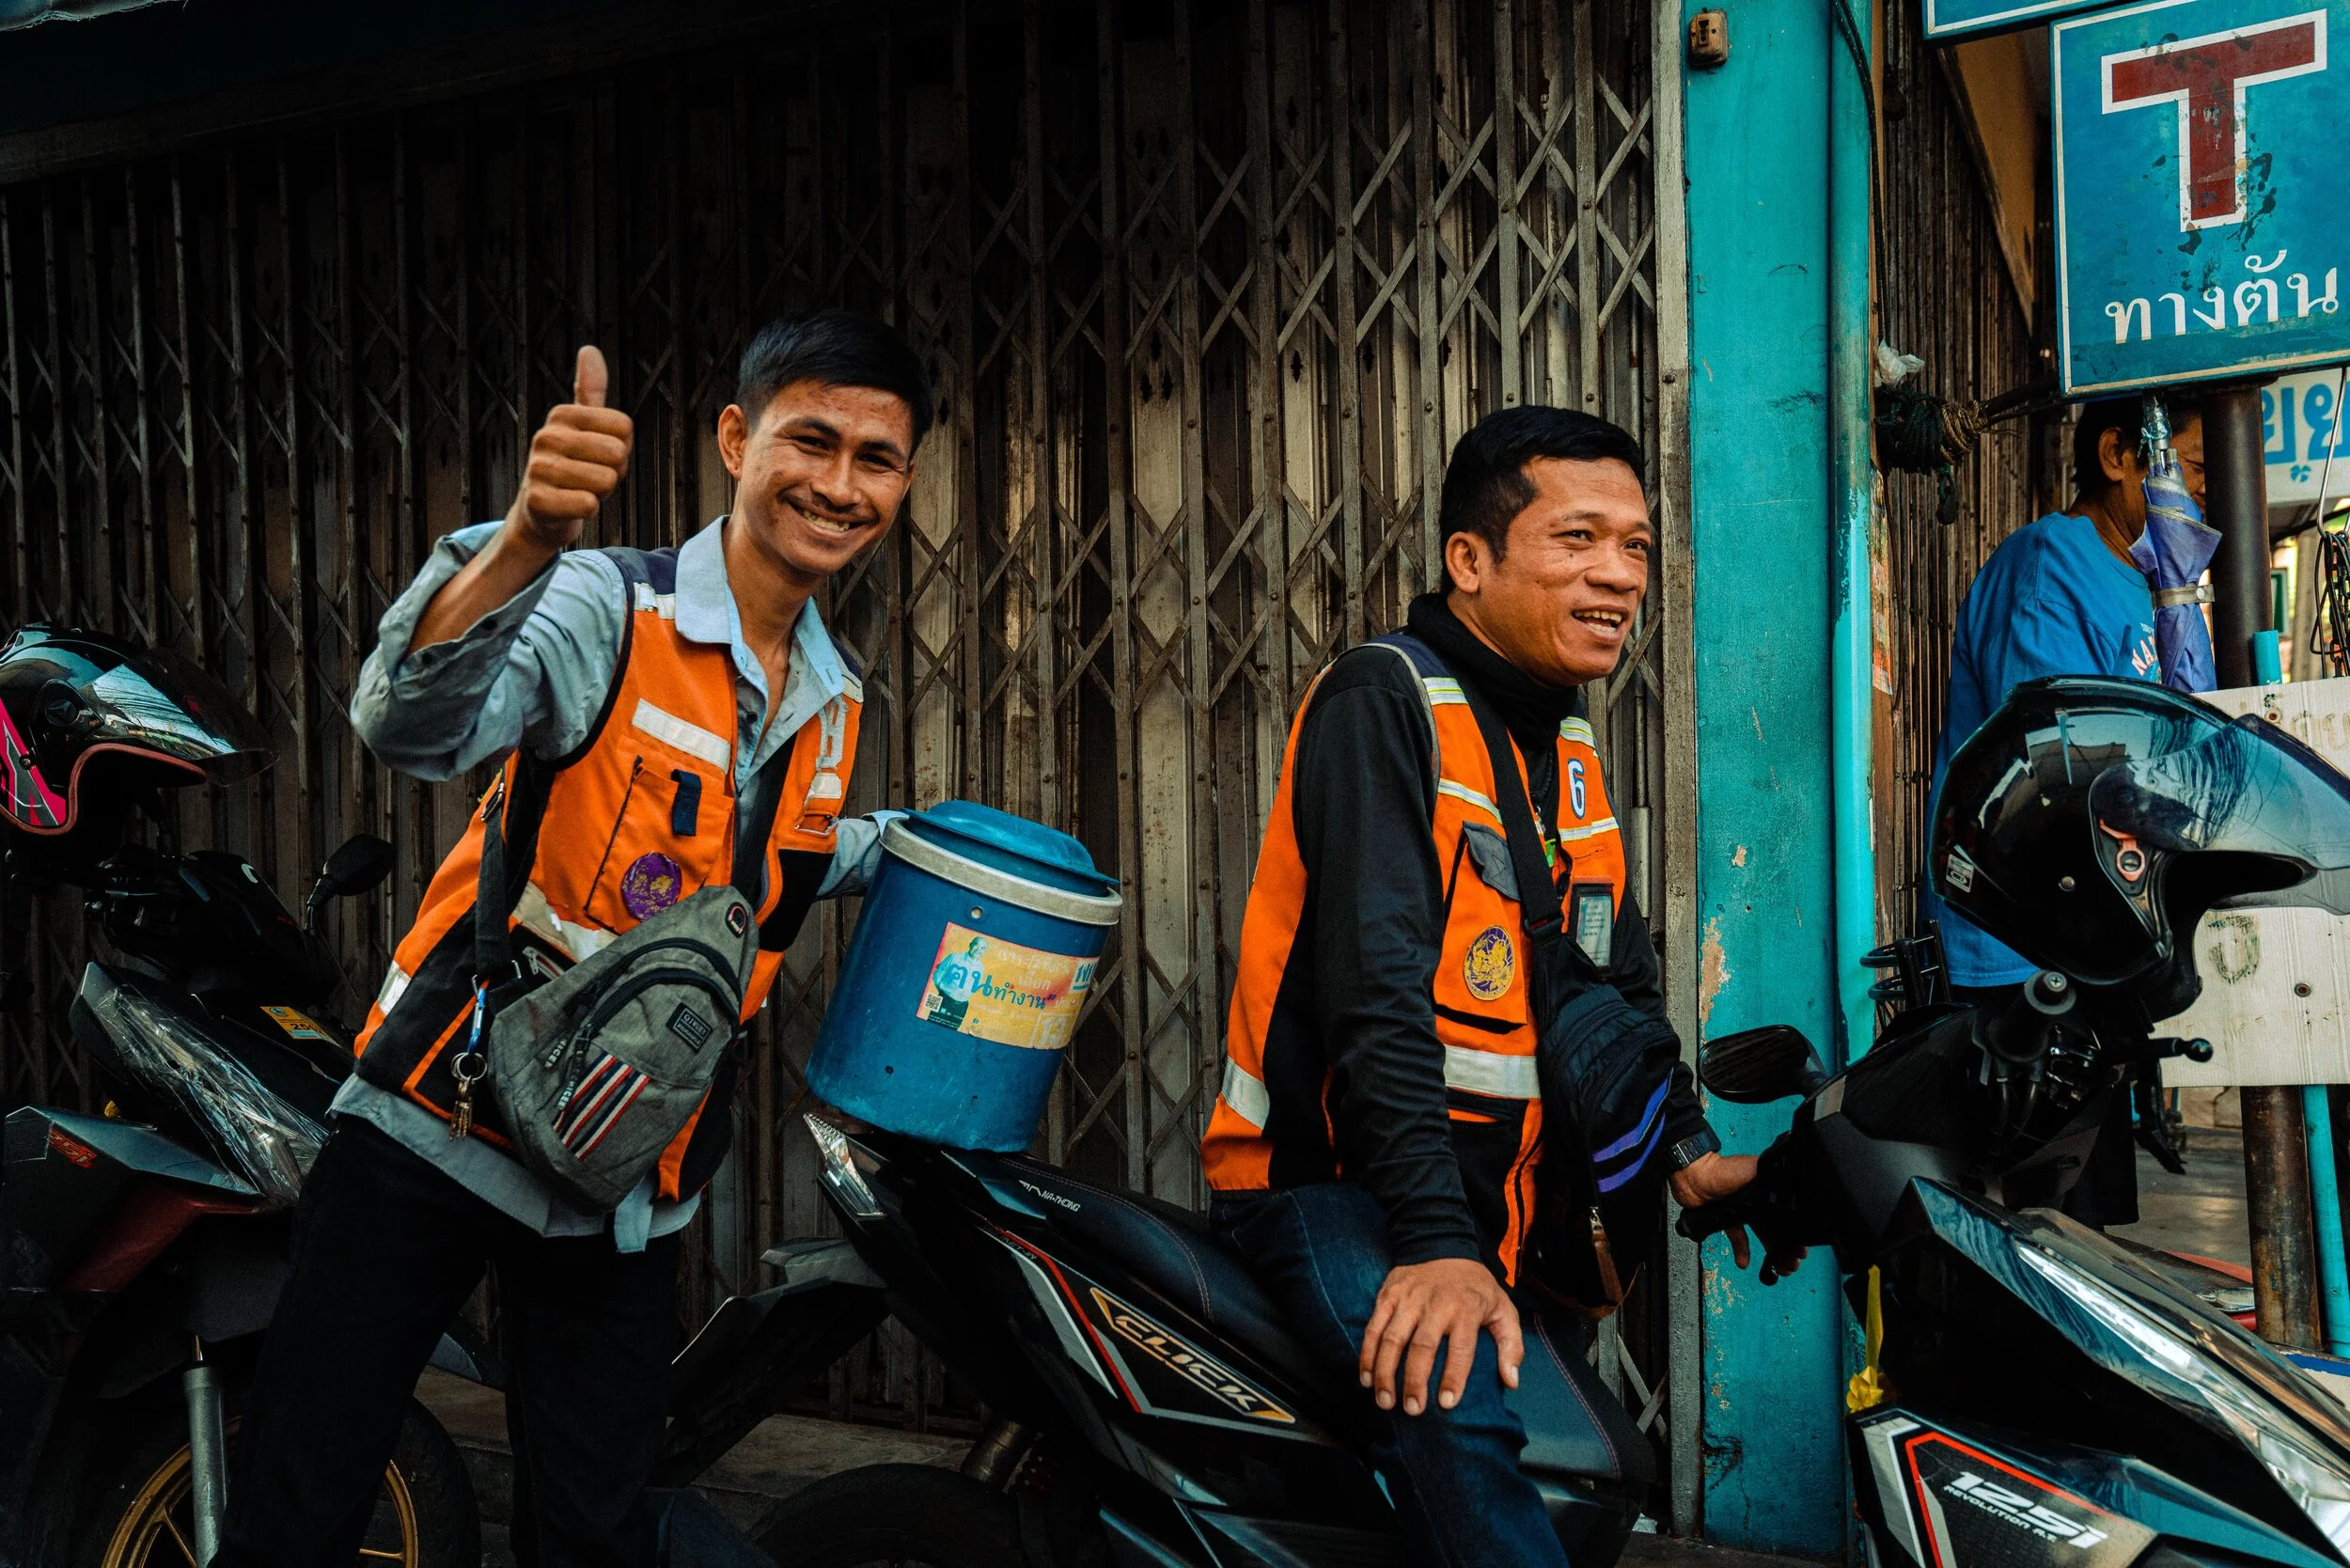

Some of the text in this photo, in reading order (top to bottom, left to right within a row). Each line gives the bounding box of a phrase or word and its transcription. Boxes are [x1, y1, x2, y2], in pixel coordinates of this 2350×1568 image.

[2104, 248, 2340, 345] ทางตัน
[1567, 758, 1586, 819] 6
[1114, 1314, 1259, 1411] CLICK
[1942, 1484, 2031, 1529] REVOLUTION
[1950, 1469, 2109, 1549] 125i
